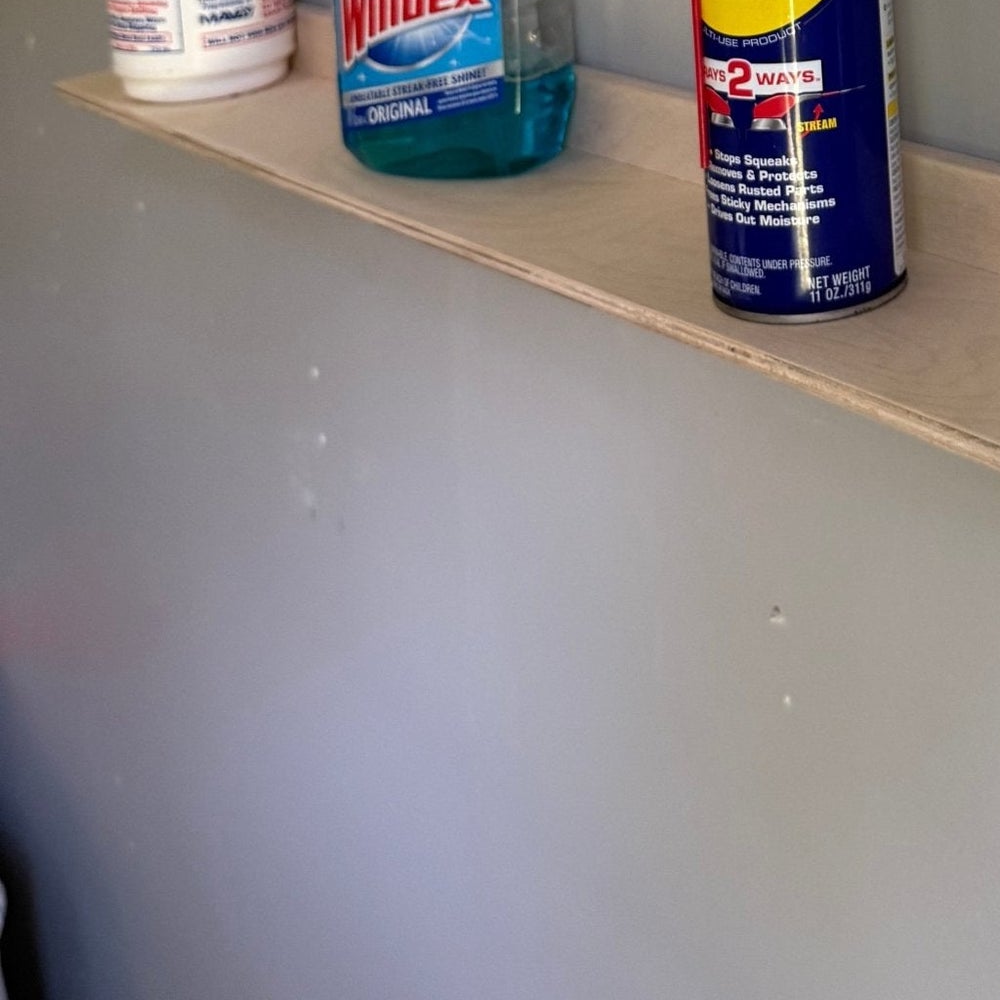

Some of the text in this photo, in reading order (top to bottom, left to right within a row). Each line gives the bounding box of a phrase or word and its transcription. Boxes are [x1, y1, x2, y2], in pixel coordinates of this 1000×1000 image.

[704, 21, 802, 48] LTI-USE PRODUCT
[393, 76, 449, 97] STREAK-FREE
[728, 58, 754, 98] 2
[756, 70, 815, 86] WAYS
[368, 97, 432, 125] ORIGINAL
[798, 117, 838, 132] STREAM
[715, 149, 798, 169] Stops Squeaks
[747, 170, 756, 181] &
[760, 170, 818, 182] Protects
[739, 183, 781, 197] Rusted
[786, 184, 824, 197] Parts
[721, 194, 836, 213] Sticky Mechanisms
[736, 214, 756, 225] Out
[760, 214, 820, 227] Moisture
[729, 253, 761, 268] CONTENTS
[762, 258, 788, 270] UNDER
[810, 266, 871, 290] NET WEIGHT
[810, 280, 872, 303] 11 OZ./311g
